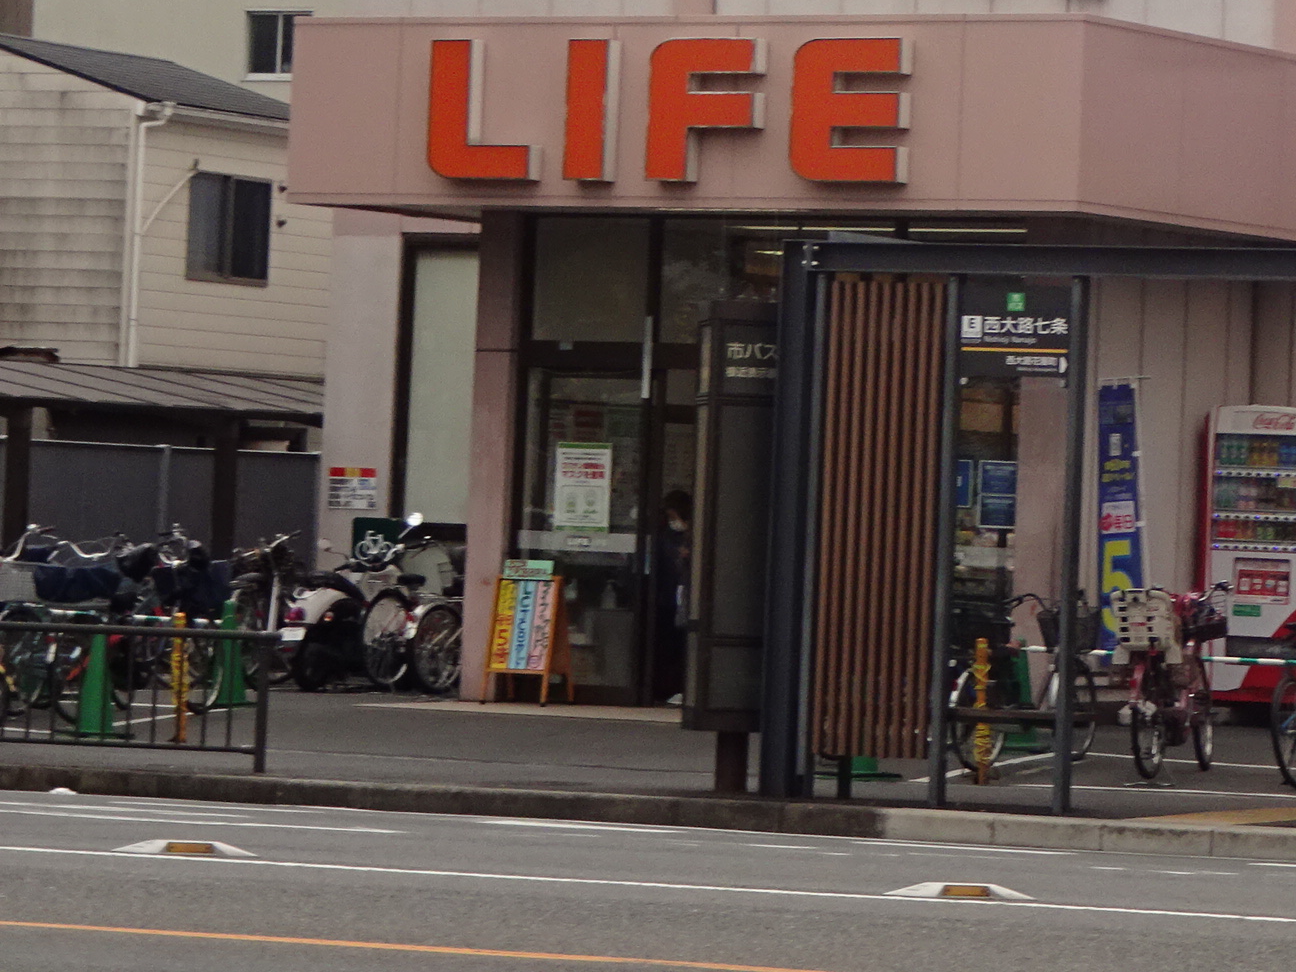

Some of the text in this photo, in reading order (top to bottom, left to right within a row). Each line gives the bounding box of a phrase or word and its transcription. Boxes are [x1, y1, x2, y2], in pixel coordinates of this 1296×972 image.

[427, 37, 913, 184] LIFE
[983, 316, 1069, 335] 西大路七条
